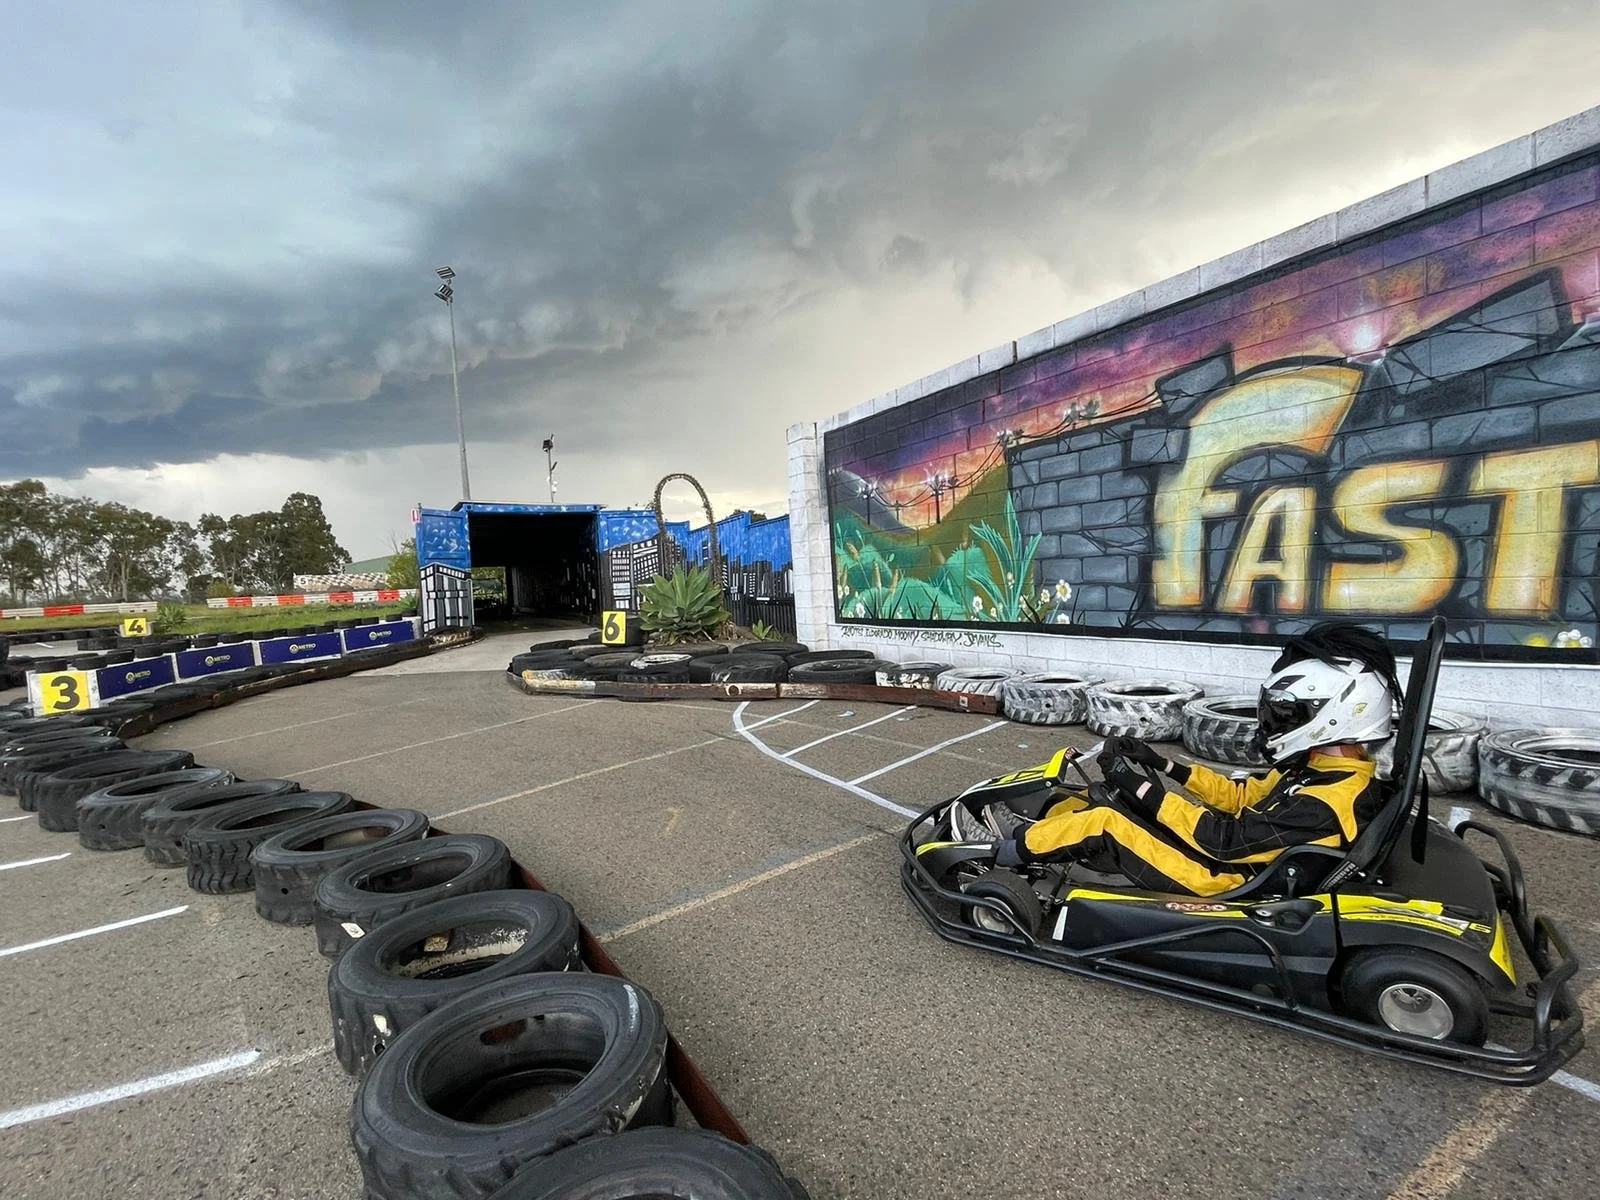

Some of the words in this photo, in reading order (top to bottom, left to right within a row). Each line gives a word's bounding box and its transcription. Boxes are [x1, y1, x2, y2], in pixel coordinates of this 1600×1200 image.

[128, 619, 144, 634] 4
[604, 613, 621, 642] 6
[50, 675, 81, 711] 3
